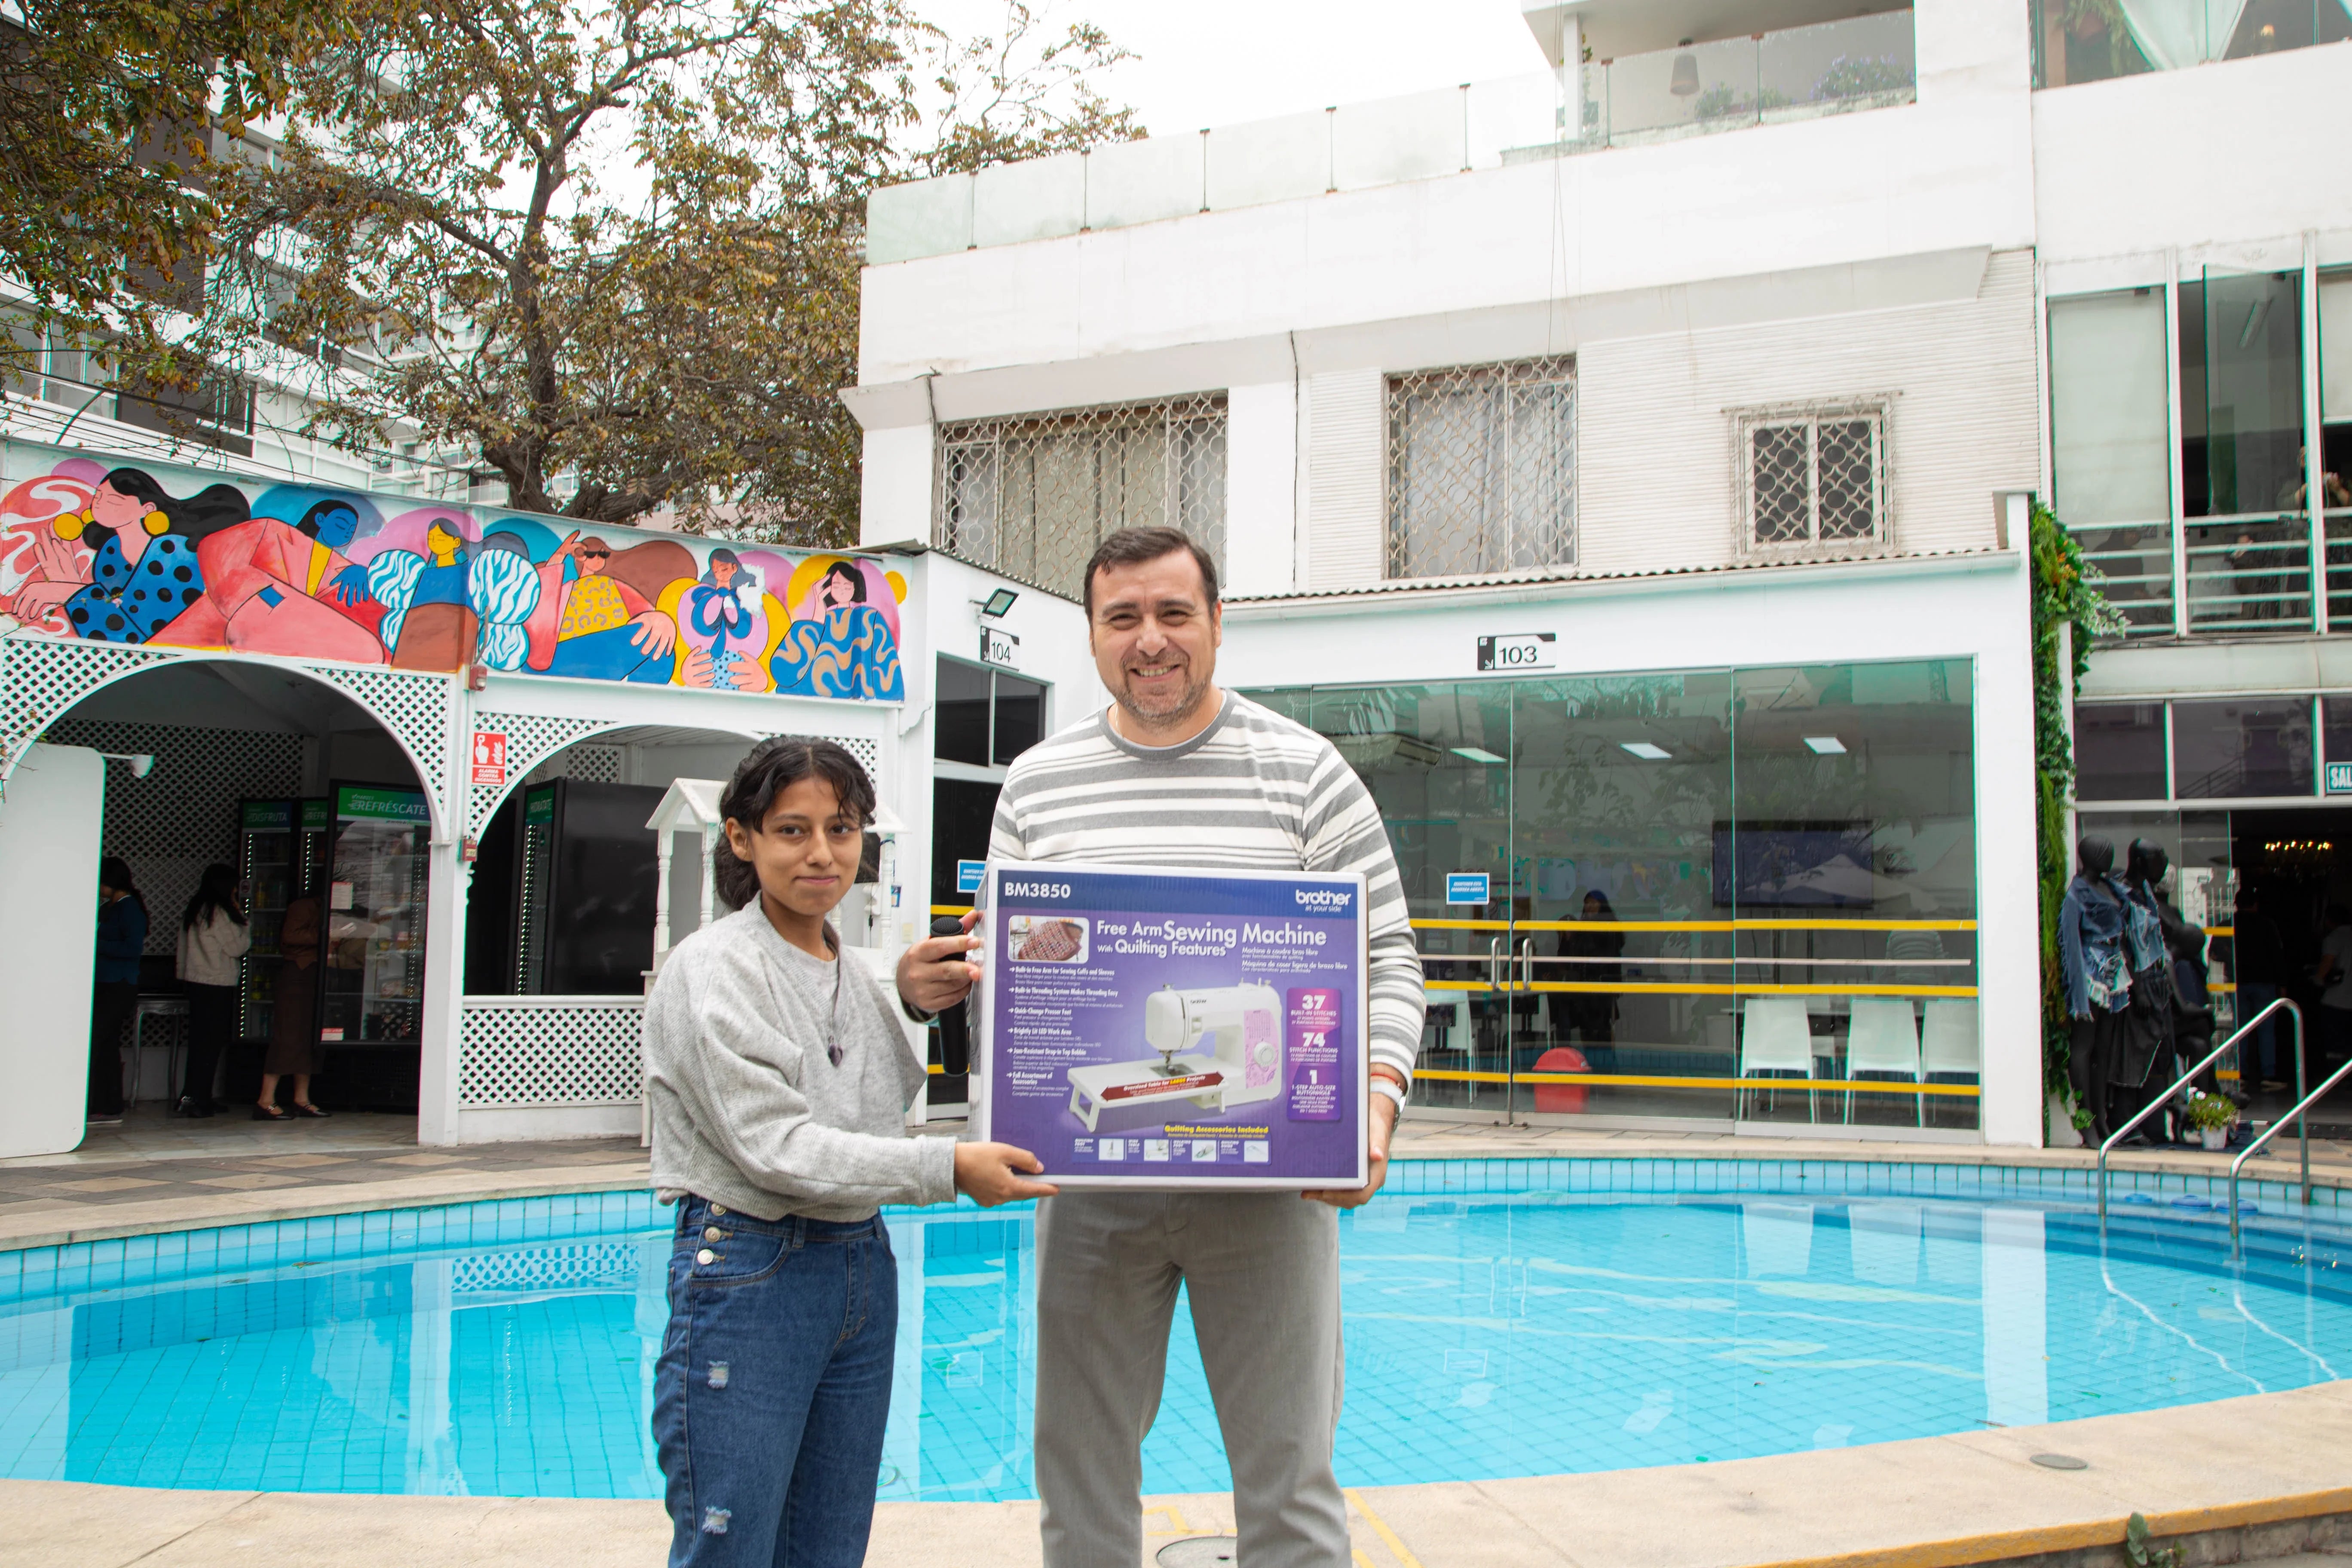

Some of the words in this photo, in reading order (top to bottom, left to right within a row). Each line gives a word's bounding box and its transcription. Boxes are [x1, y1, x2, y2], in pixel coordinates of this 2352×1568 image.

[992, 641, 1011, 663] 104
[1499, 646, 1537, 664] 103
[358, 799, 427, 815] REFRÉSCATE
[1004, 882, 1071, 898] BM3850
[1295, 889, 1351, 905] brother
[1097, 920, 1127, 935] Free
[1132, 921, 1162, 937] Arm
[1164, 920, 1237, 948] Sewing
[1242, 922, 1327, 945] Machine
[1097, 945, 1113, 953] With
[1115, 938, 1167, 959] Quilting
[1171, 941, 1226, 957] Features
[1060, 967, 1076, 975] Sewing
[1317, 962, 1334, 970] brazo
[1032, 987, 1053, 996] Threading
[1054, 988, 1070, 996] System
[1086, 989, 1107, 998] Threading
[1108, 989, 1118, 998] Easy
[1302, 995, 1326, 1010] 37
[1014, 1027, 1031, 1035] Brightly
[1303, 1032, 1326, 1047] 74
[1063, 1048, 1071, 1057] Top
[1021, 1072, 1047, 1080] Assortment
[1309, 1069, 1318, 1084] 1
[1164, 1125, 1194, 1133] Quilting
[1196, 1125, 1236, 1133] Accessories
